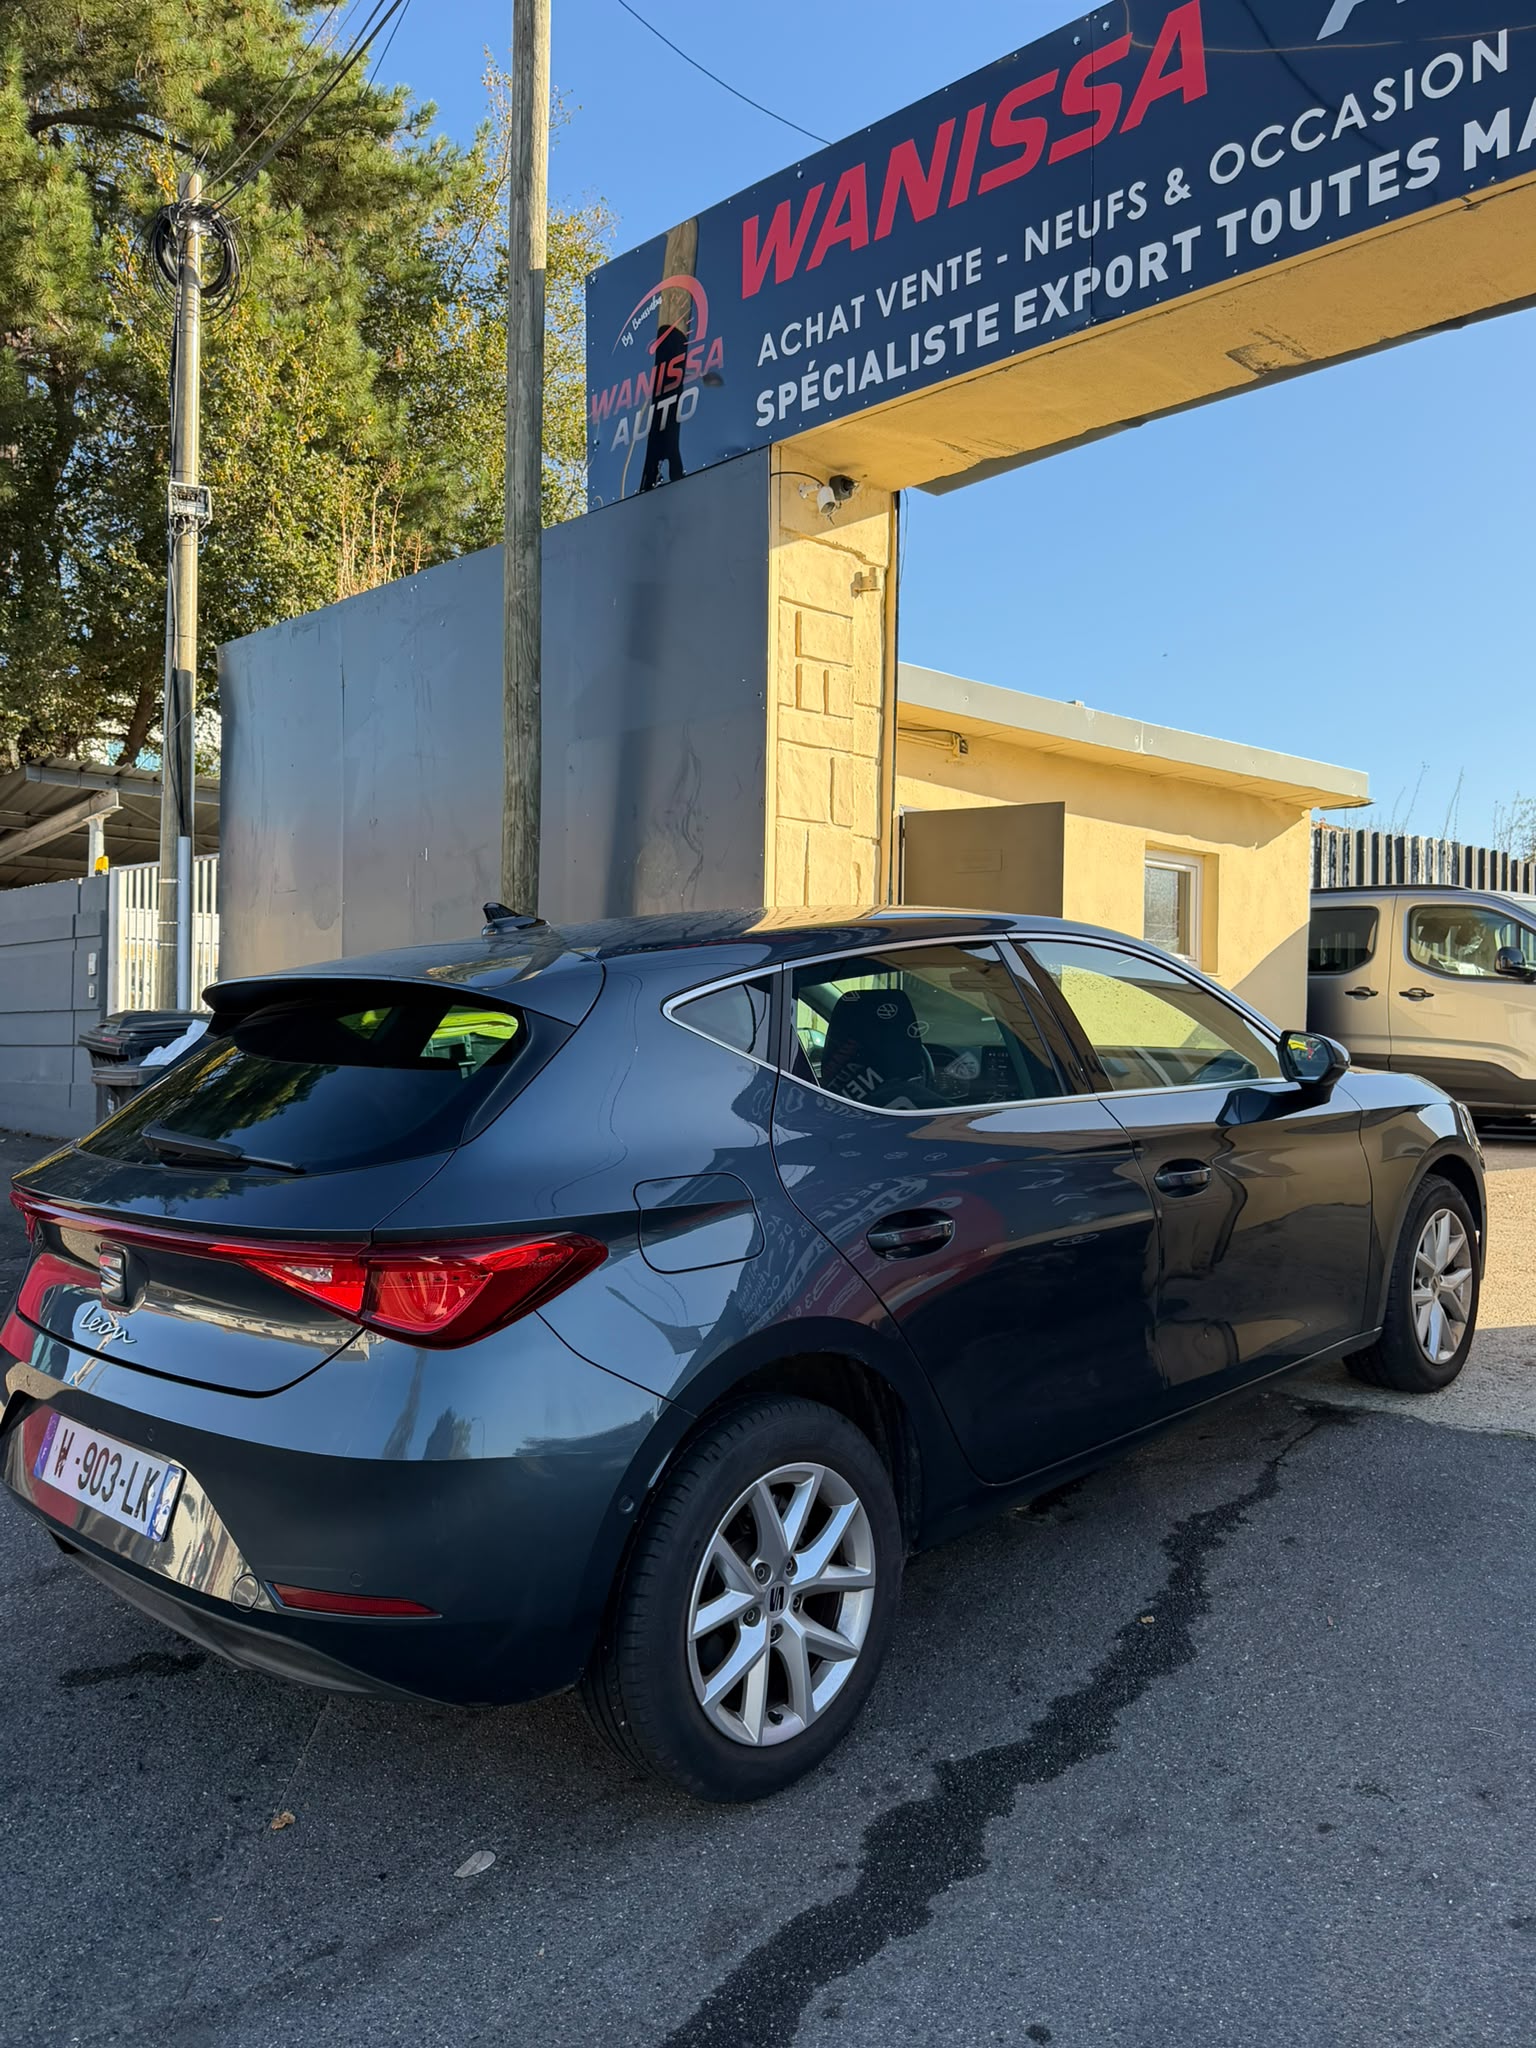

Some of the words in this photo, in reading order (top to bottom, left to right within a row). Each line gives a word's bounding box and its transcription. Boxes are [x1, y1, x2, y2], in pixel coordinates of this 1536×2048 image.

[742, 0, 1207, 299] WANISSA
[756, 303, 999, 427] SPÉCIALISTE
[1015, 226, 1201, 334] EXPORT
[1217, 137, 1440, 257] TOUTES
[757, 295, 865, 367] ACHAT
[876, 247, 982, 318] VENTE
[1025, 181, 1147, 262] NEUFS
[1165, 168, 1192, 206] &
[1210, 28, 1508, 185] OCCASION
[591, 336, 724, 424] WANISSA
[610, 386, 699, 452] AUTO
